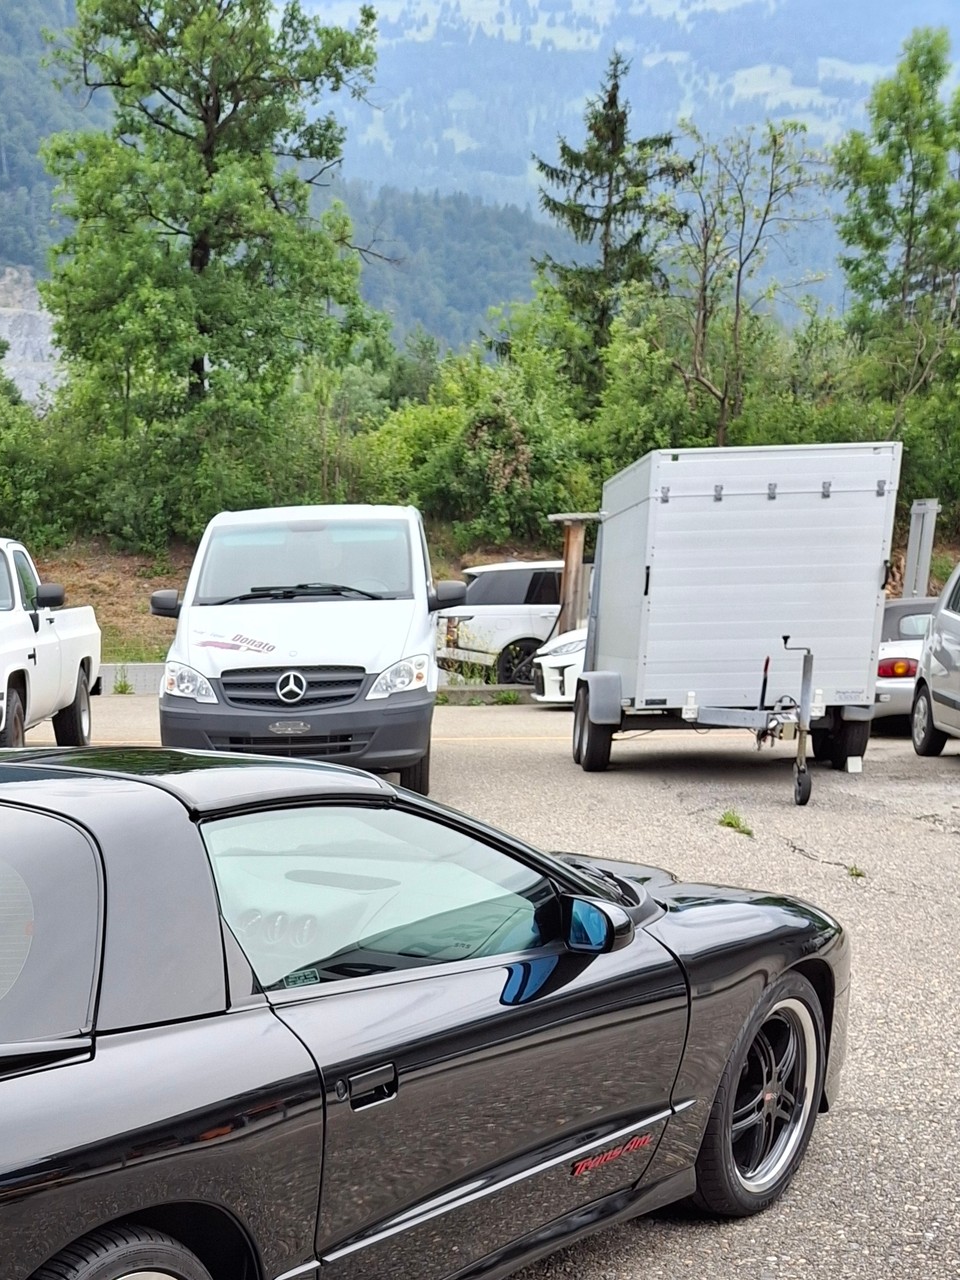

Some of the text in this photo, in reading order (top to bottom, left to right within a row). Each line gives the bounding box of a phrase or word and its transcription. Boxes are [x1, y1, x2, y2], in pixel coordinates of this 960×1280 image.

[231, 633, 276, 653] Donato
[571, 1133, 653, 1177] Trans Am
